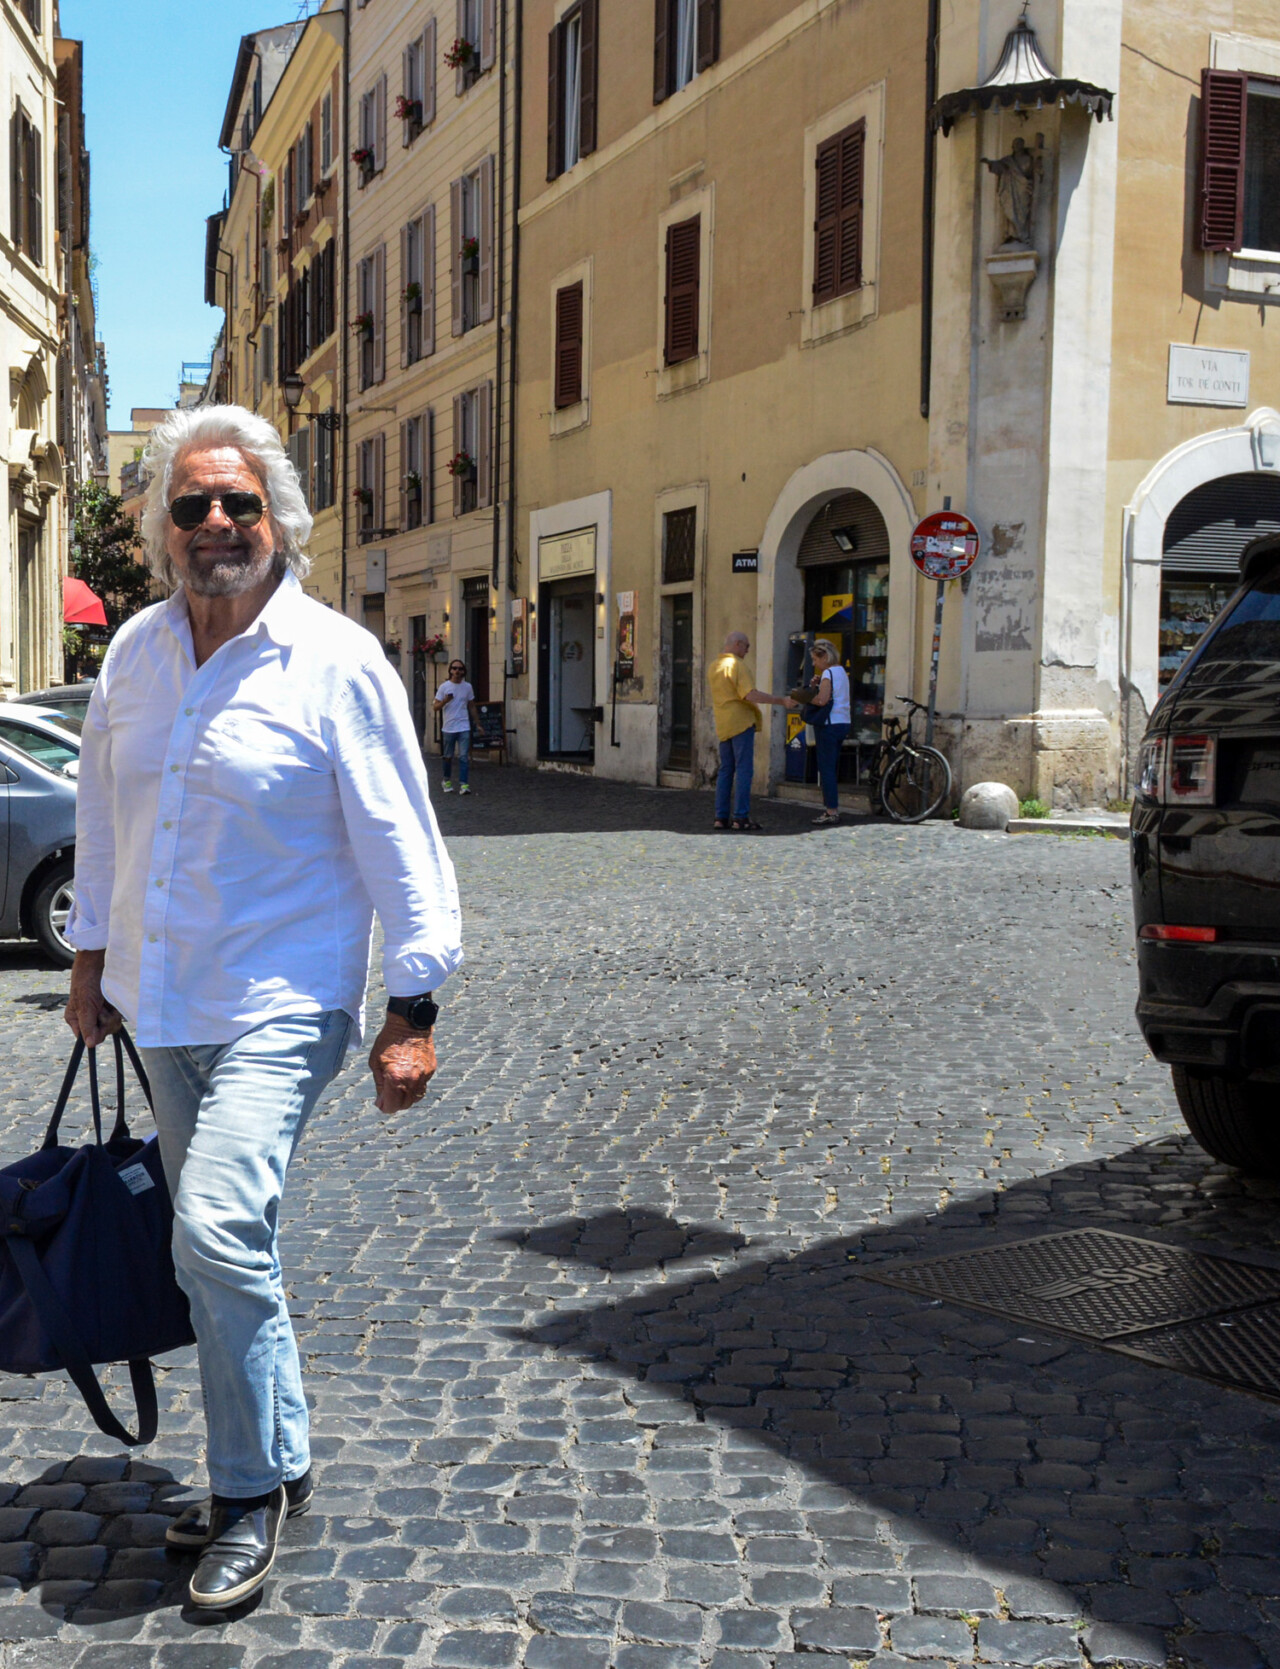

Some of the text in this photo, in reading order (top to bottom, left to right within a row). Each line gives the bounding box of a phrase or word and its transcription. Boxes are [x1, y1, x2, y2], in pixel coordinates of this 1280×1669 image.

[1201, 359, 1218, 372] VIA
[1176, 376, 1194, 388] TOR
[1212, 379, 1241, 393] CONTI
[735, 558, 757, 567] ATM
[832, 599, 843, 608] ATM
[1093, 1262, 1171, 1284] SIP
